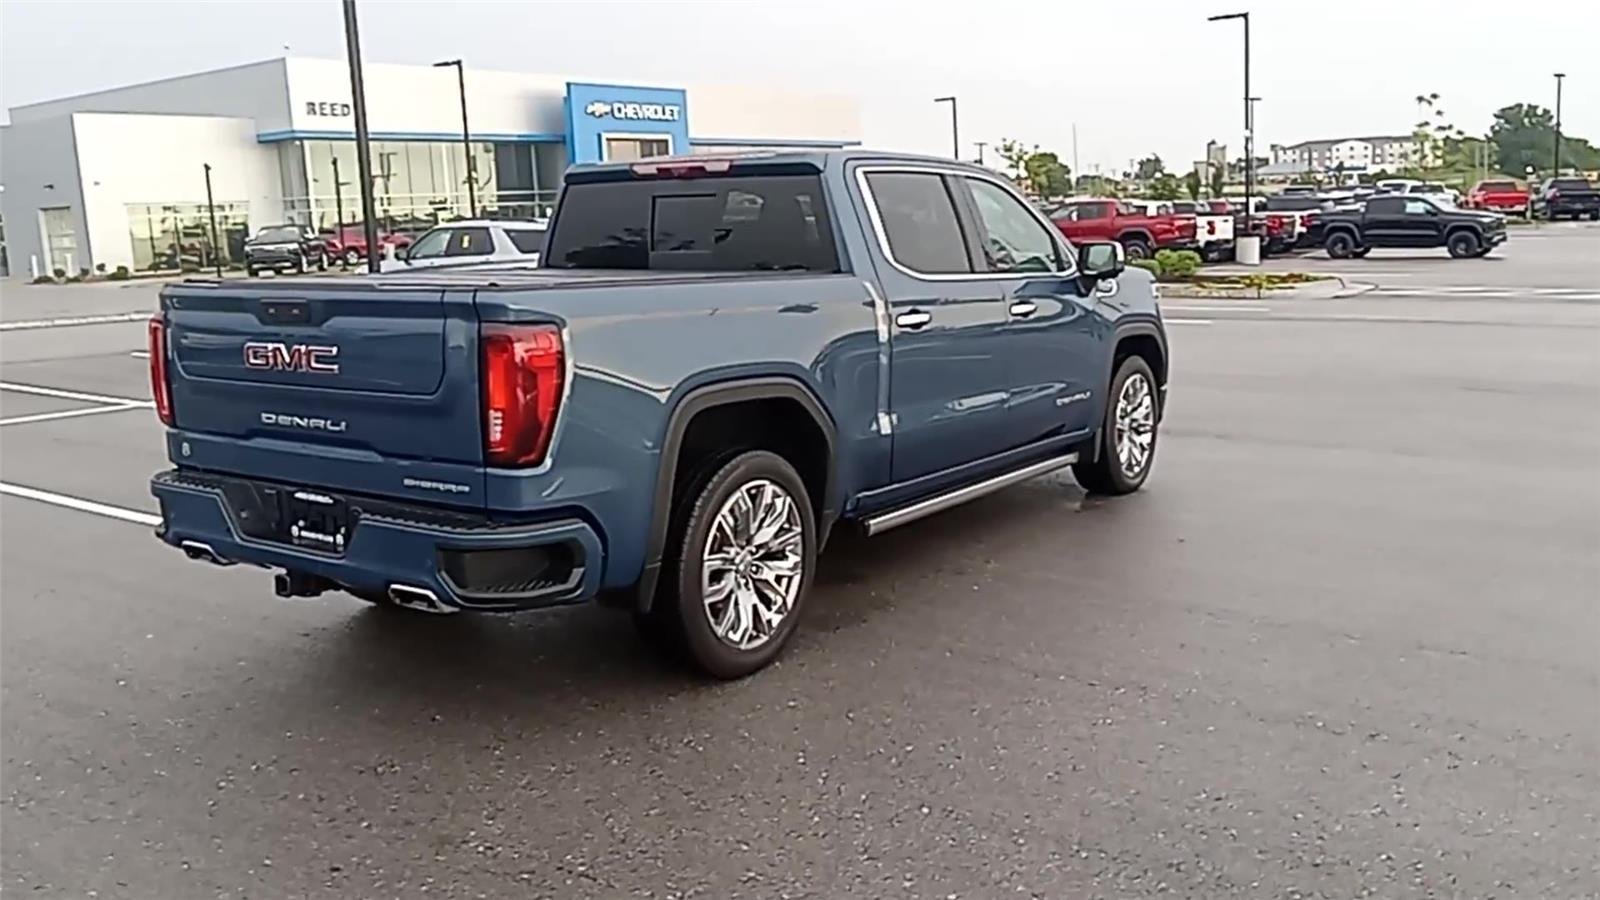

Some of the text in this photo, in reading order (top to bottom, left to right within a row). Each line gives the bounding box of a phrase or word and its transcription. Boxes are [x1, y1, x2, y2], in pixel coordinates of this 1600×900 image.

[305, 102, 351, 116] REED
[612, 102, 680, 120] CHEVROLET
[243, 342, 339, 374] GMC
[260, 412, 347, 431] DENALI
